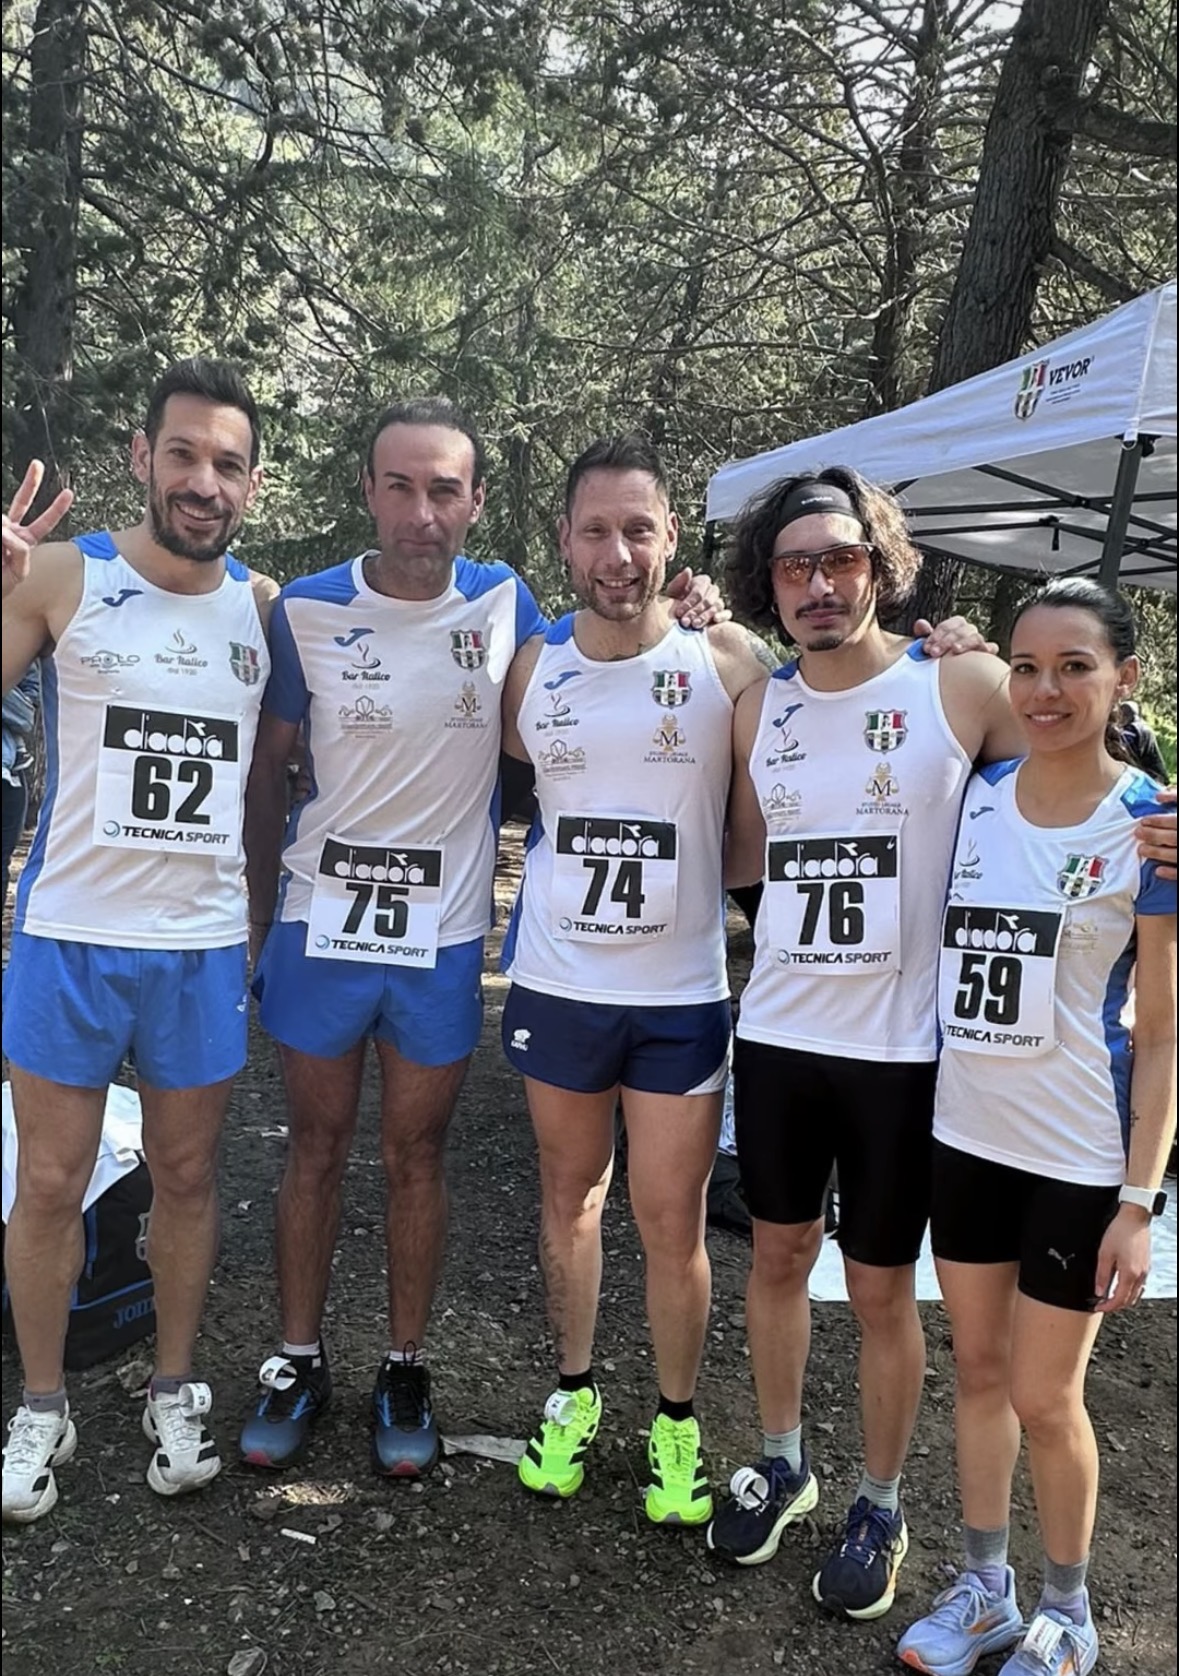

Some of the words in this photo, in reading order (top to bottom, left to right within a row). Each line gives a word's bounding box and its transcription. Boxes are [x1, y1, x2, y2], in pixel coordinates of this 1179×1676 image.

[1049, 357, 1091, 386] VEVOR
[154, 653, 174, 663] Bar
[124, 712, 223, 758] diadora
[131, 755, 213, 825] 62
[571, 821, 659, 857] diadora
[784, 841, 878, 878] diadora
[335, 848, 425, 883] diadora
[581, 858, 645, 918] 74
[342, 882, 410, 939] 75
[797, 881, 864, 945] 76
[955, 910, 1037, 952] diadora
[954, 952, 1023, 1025] 59
